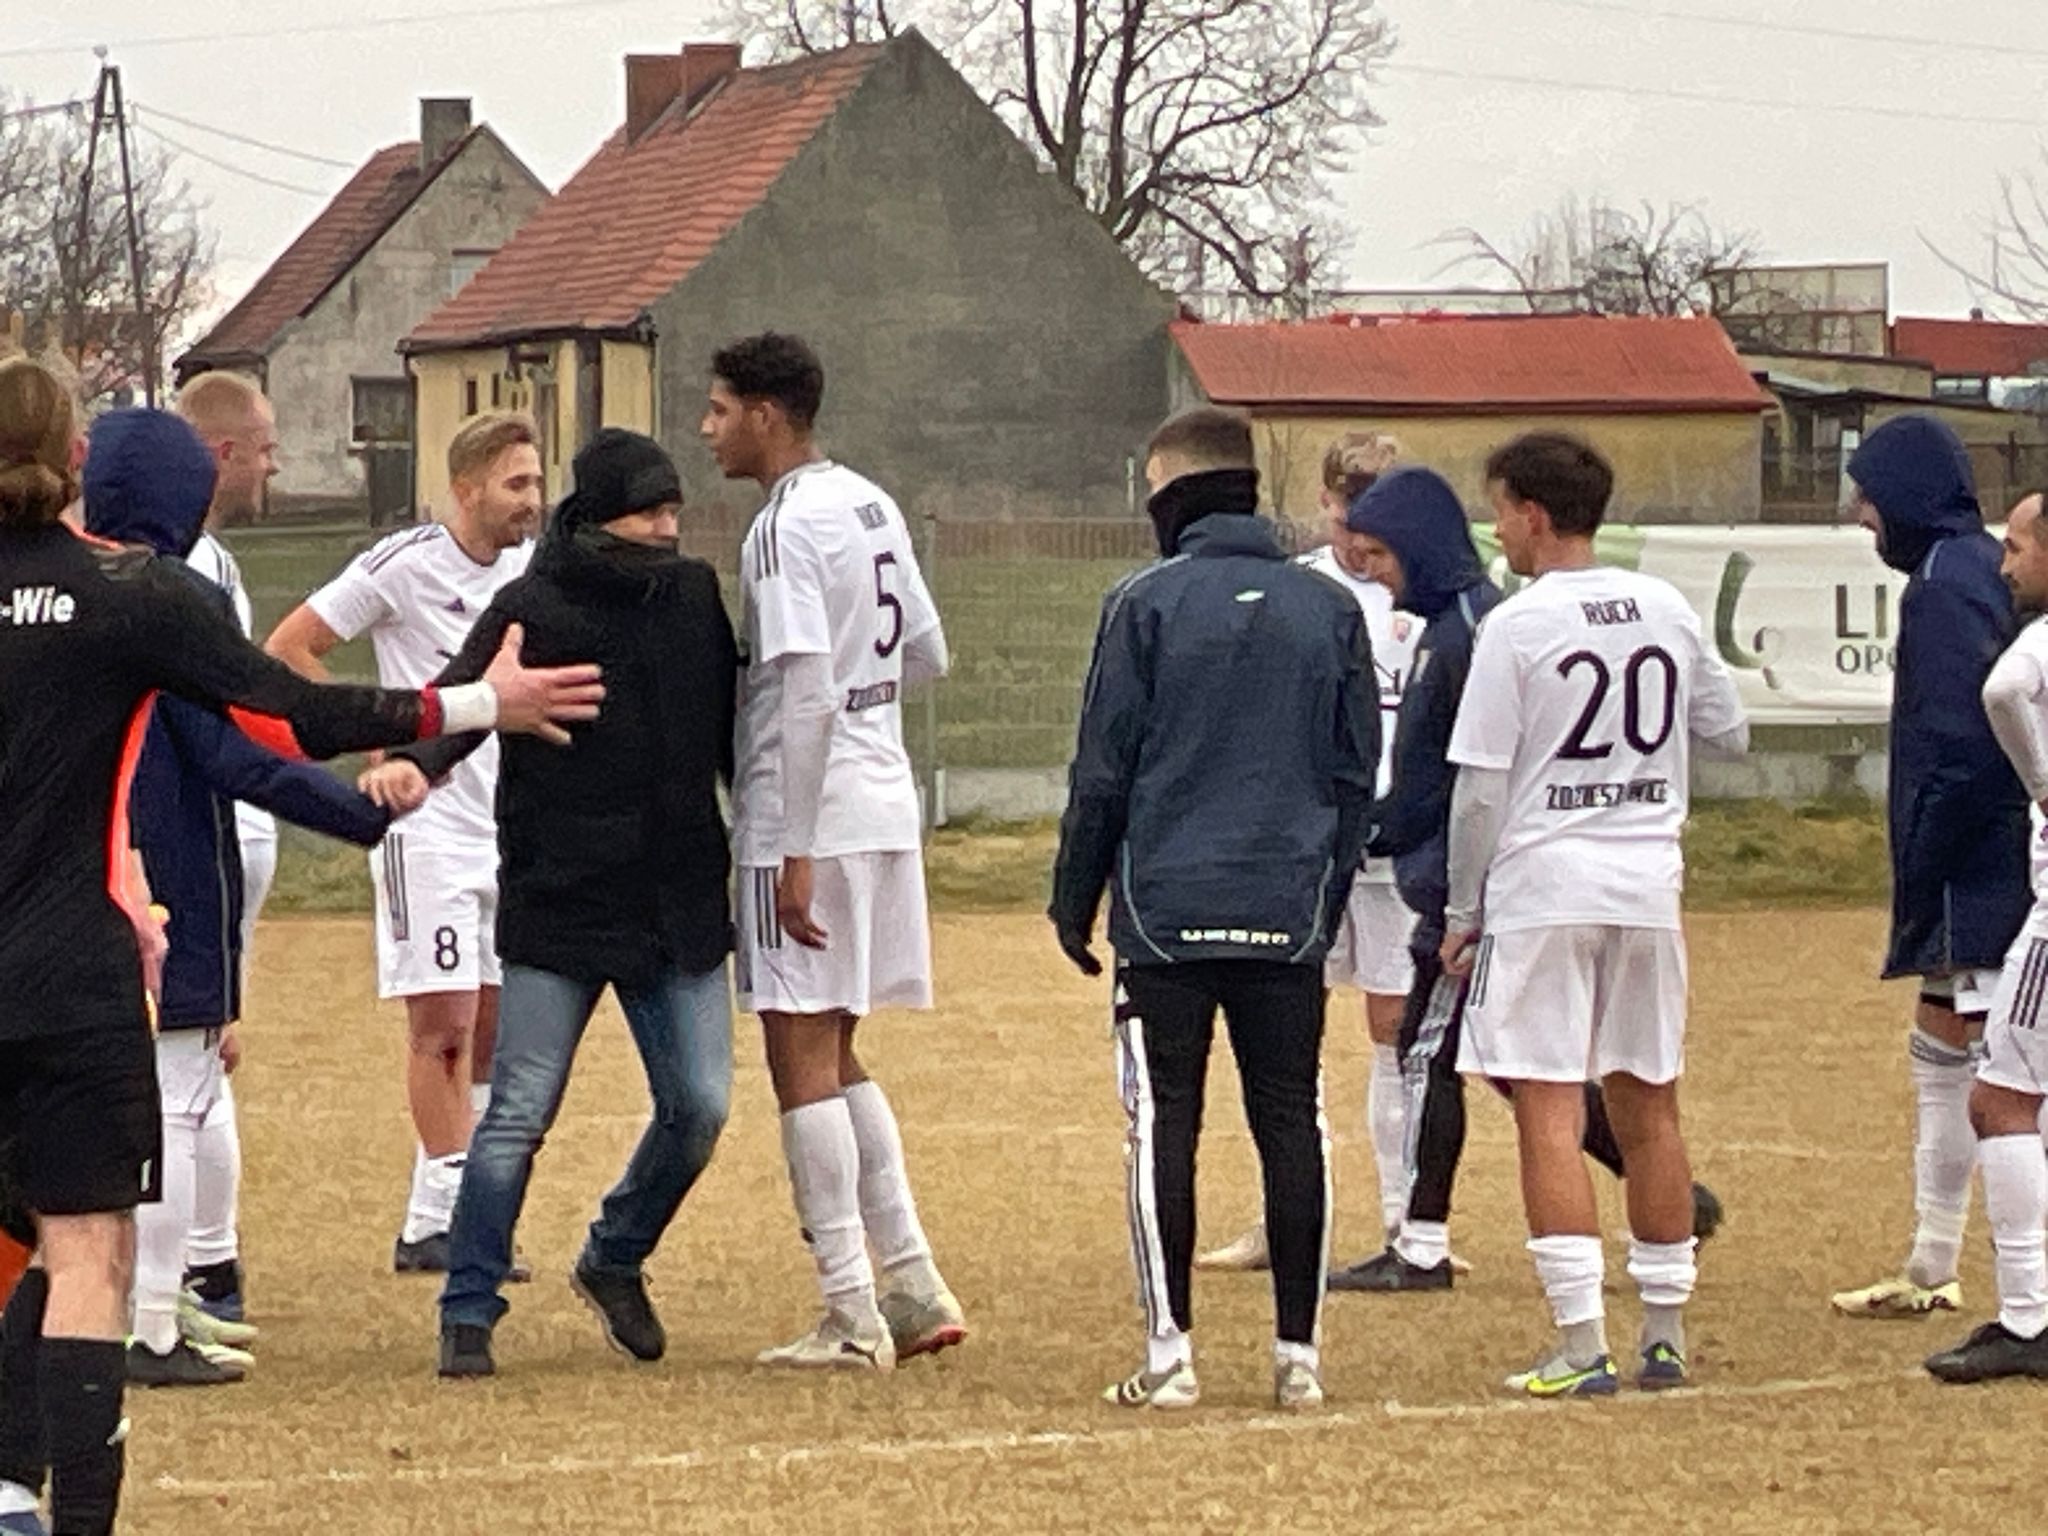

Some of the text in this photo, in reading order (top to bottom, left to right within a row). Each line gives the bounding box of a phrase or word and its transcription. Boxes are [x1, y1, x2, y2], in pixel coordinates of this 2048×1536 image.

[0, 585, 76, 625] -Wie
[873, 550, 903, 659] 5
[1555, 645, 1678, 760] 20
[435, 925, 460, 971] 8
